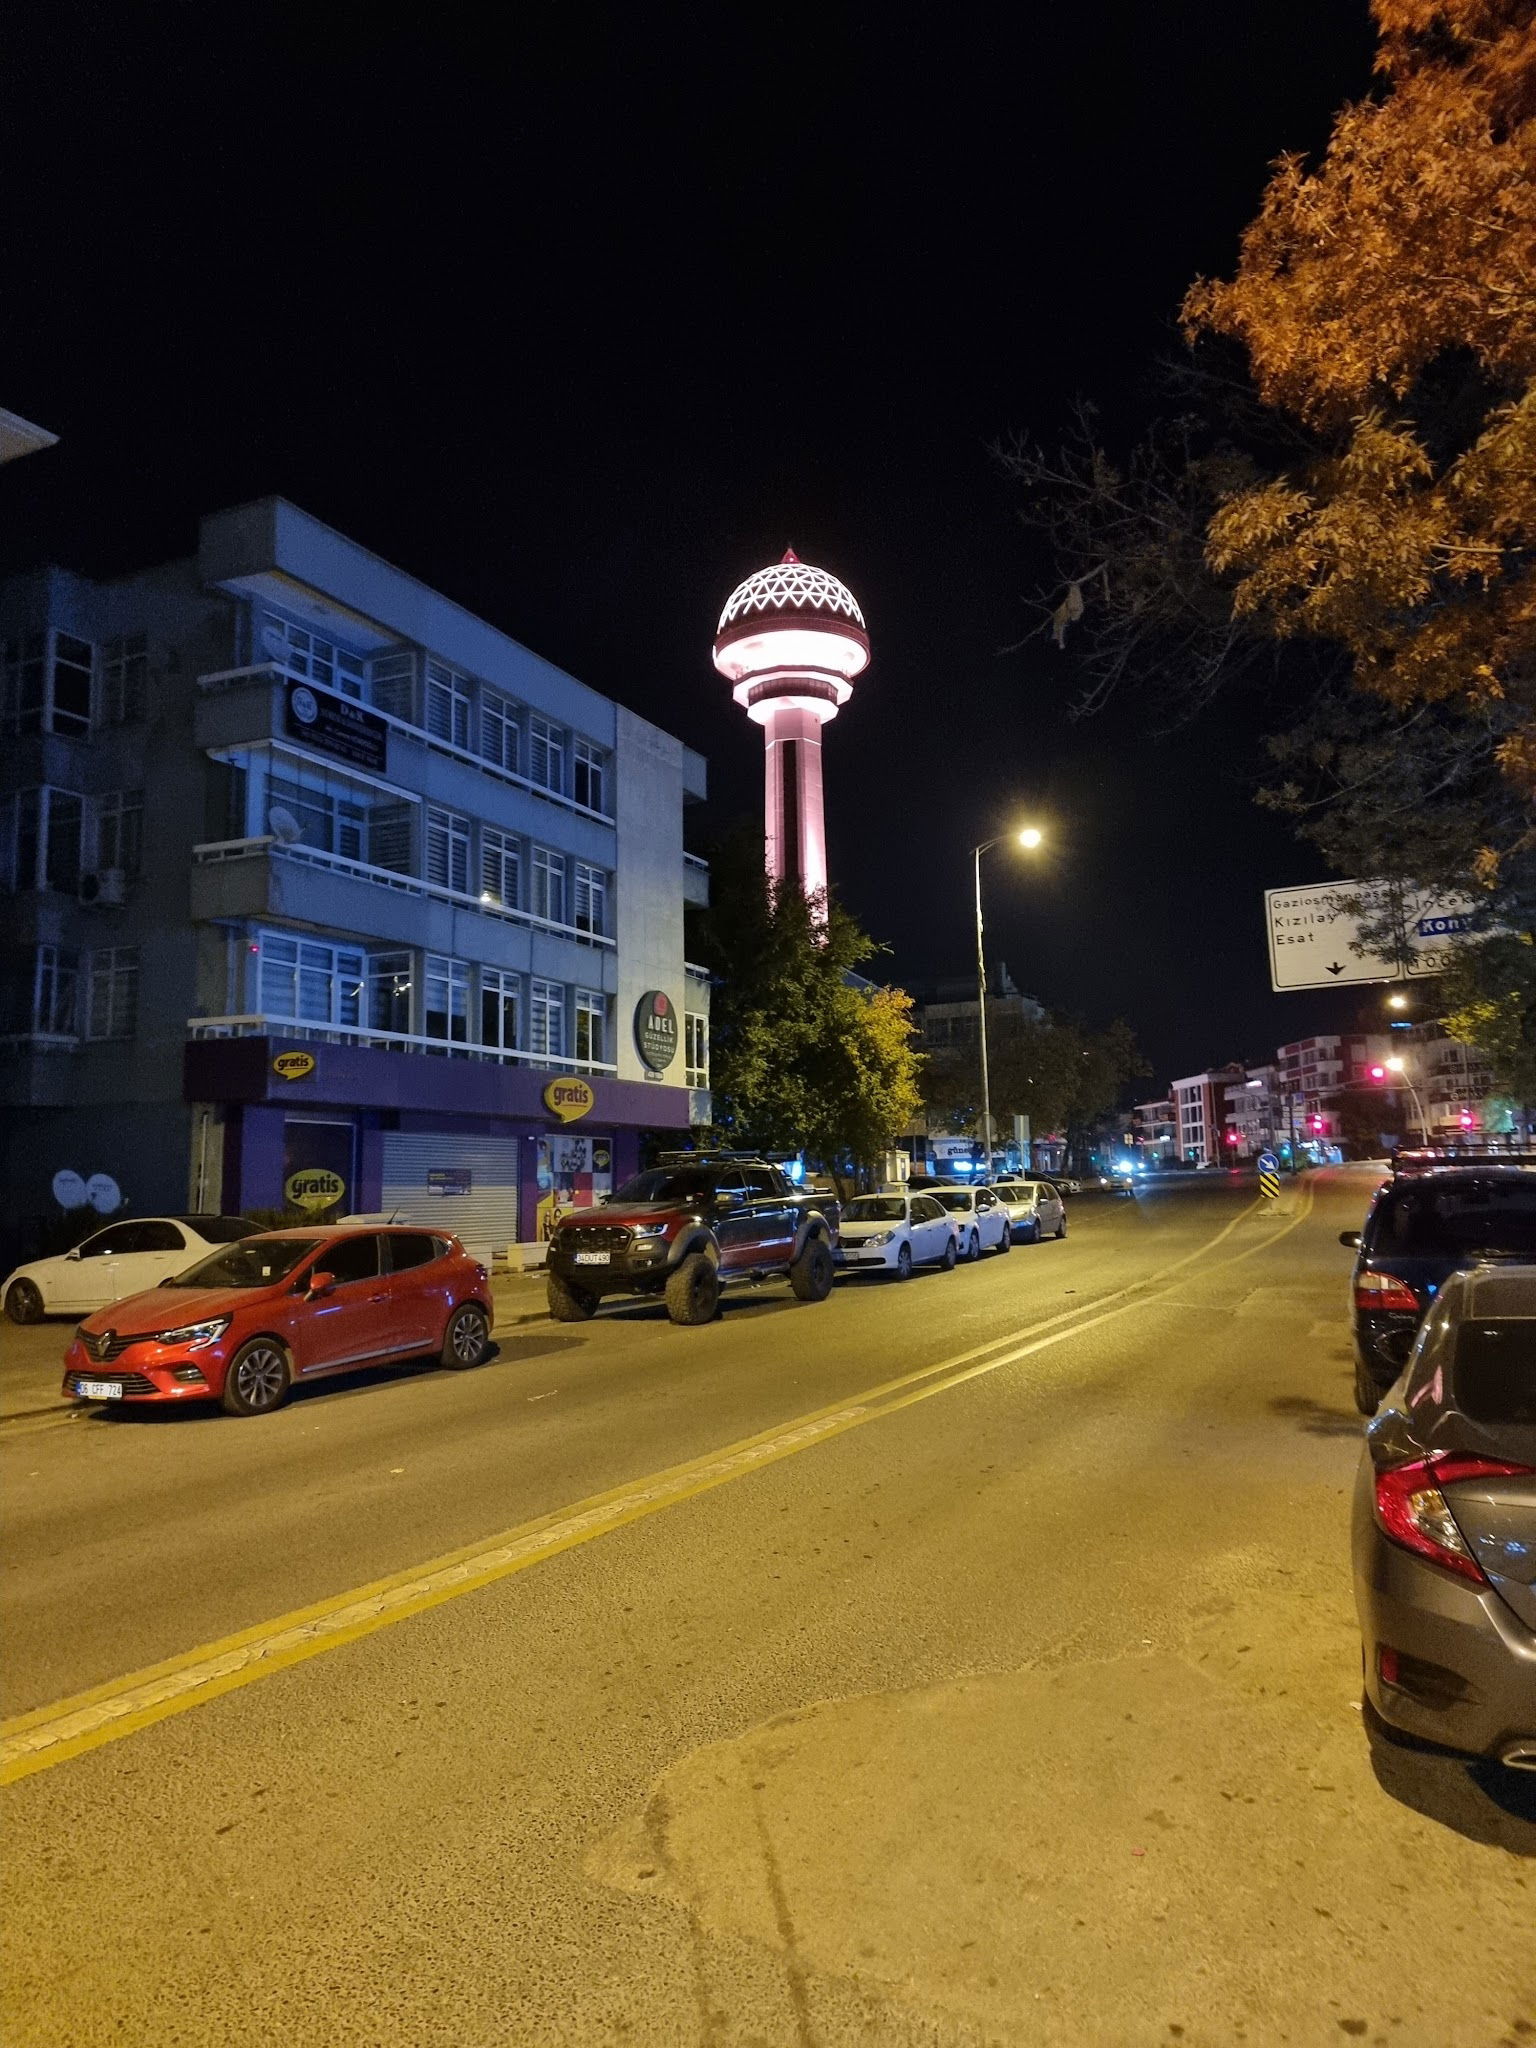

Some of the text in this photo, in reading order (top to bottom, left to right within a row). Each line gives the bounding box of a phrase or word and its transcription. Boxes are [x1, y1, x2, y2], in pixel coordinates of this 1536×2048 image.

[1274, 913, 1338, 927] Kızılay
[1276, 932, 1314, 945] Esat
[648, 1015, 674, 1034] ADEL
[278, 1055, 309, 1070] gratis
[553, 1085, 588, 1106] gratis
[291, 1174, 339, 1199] gratis
